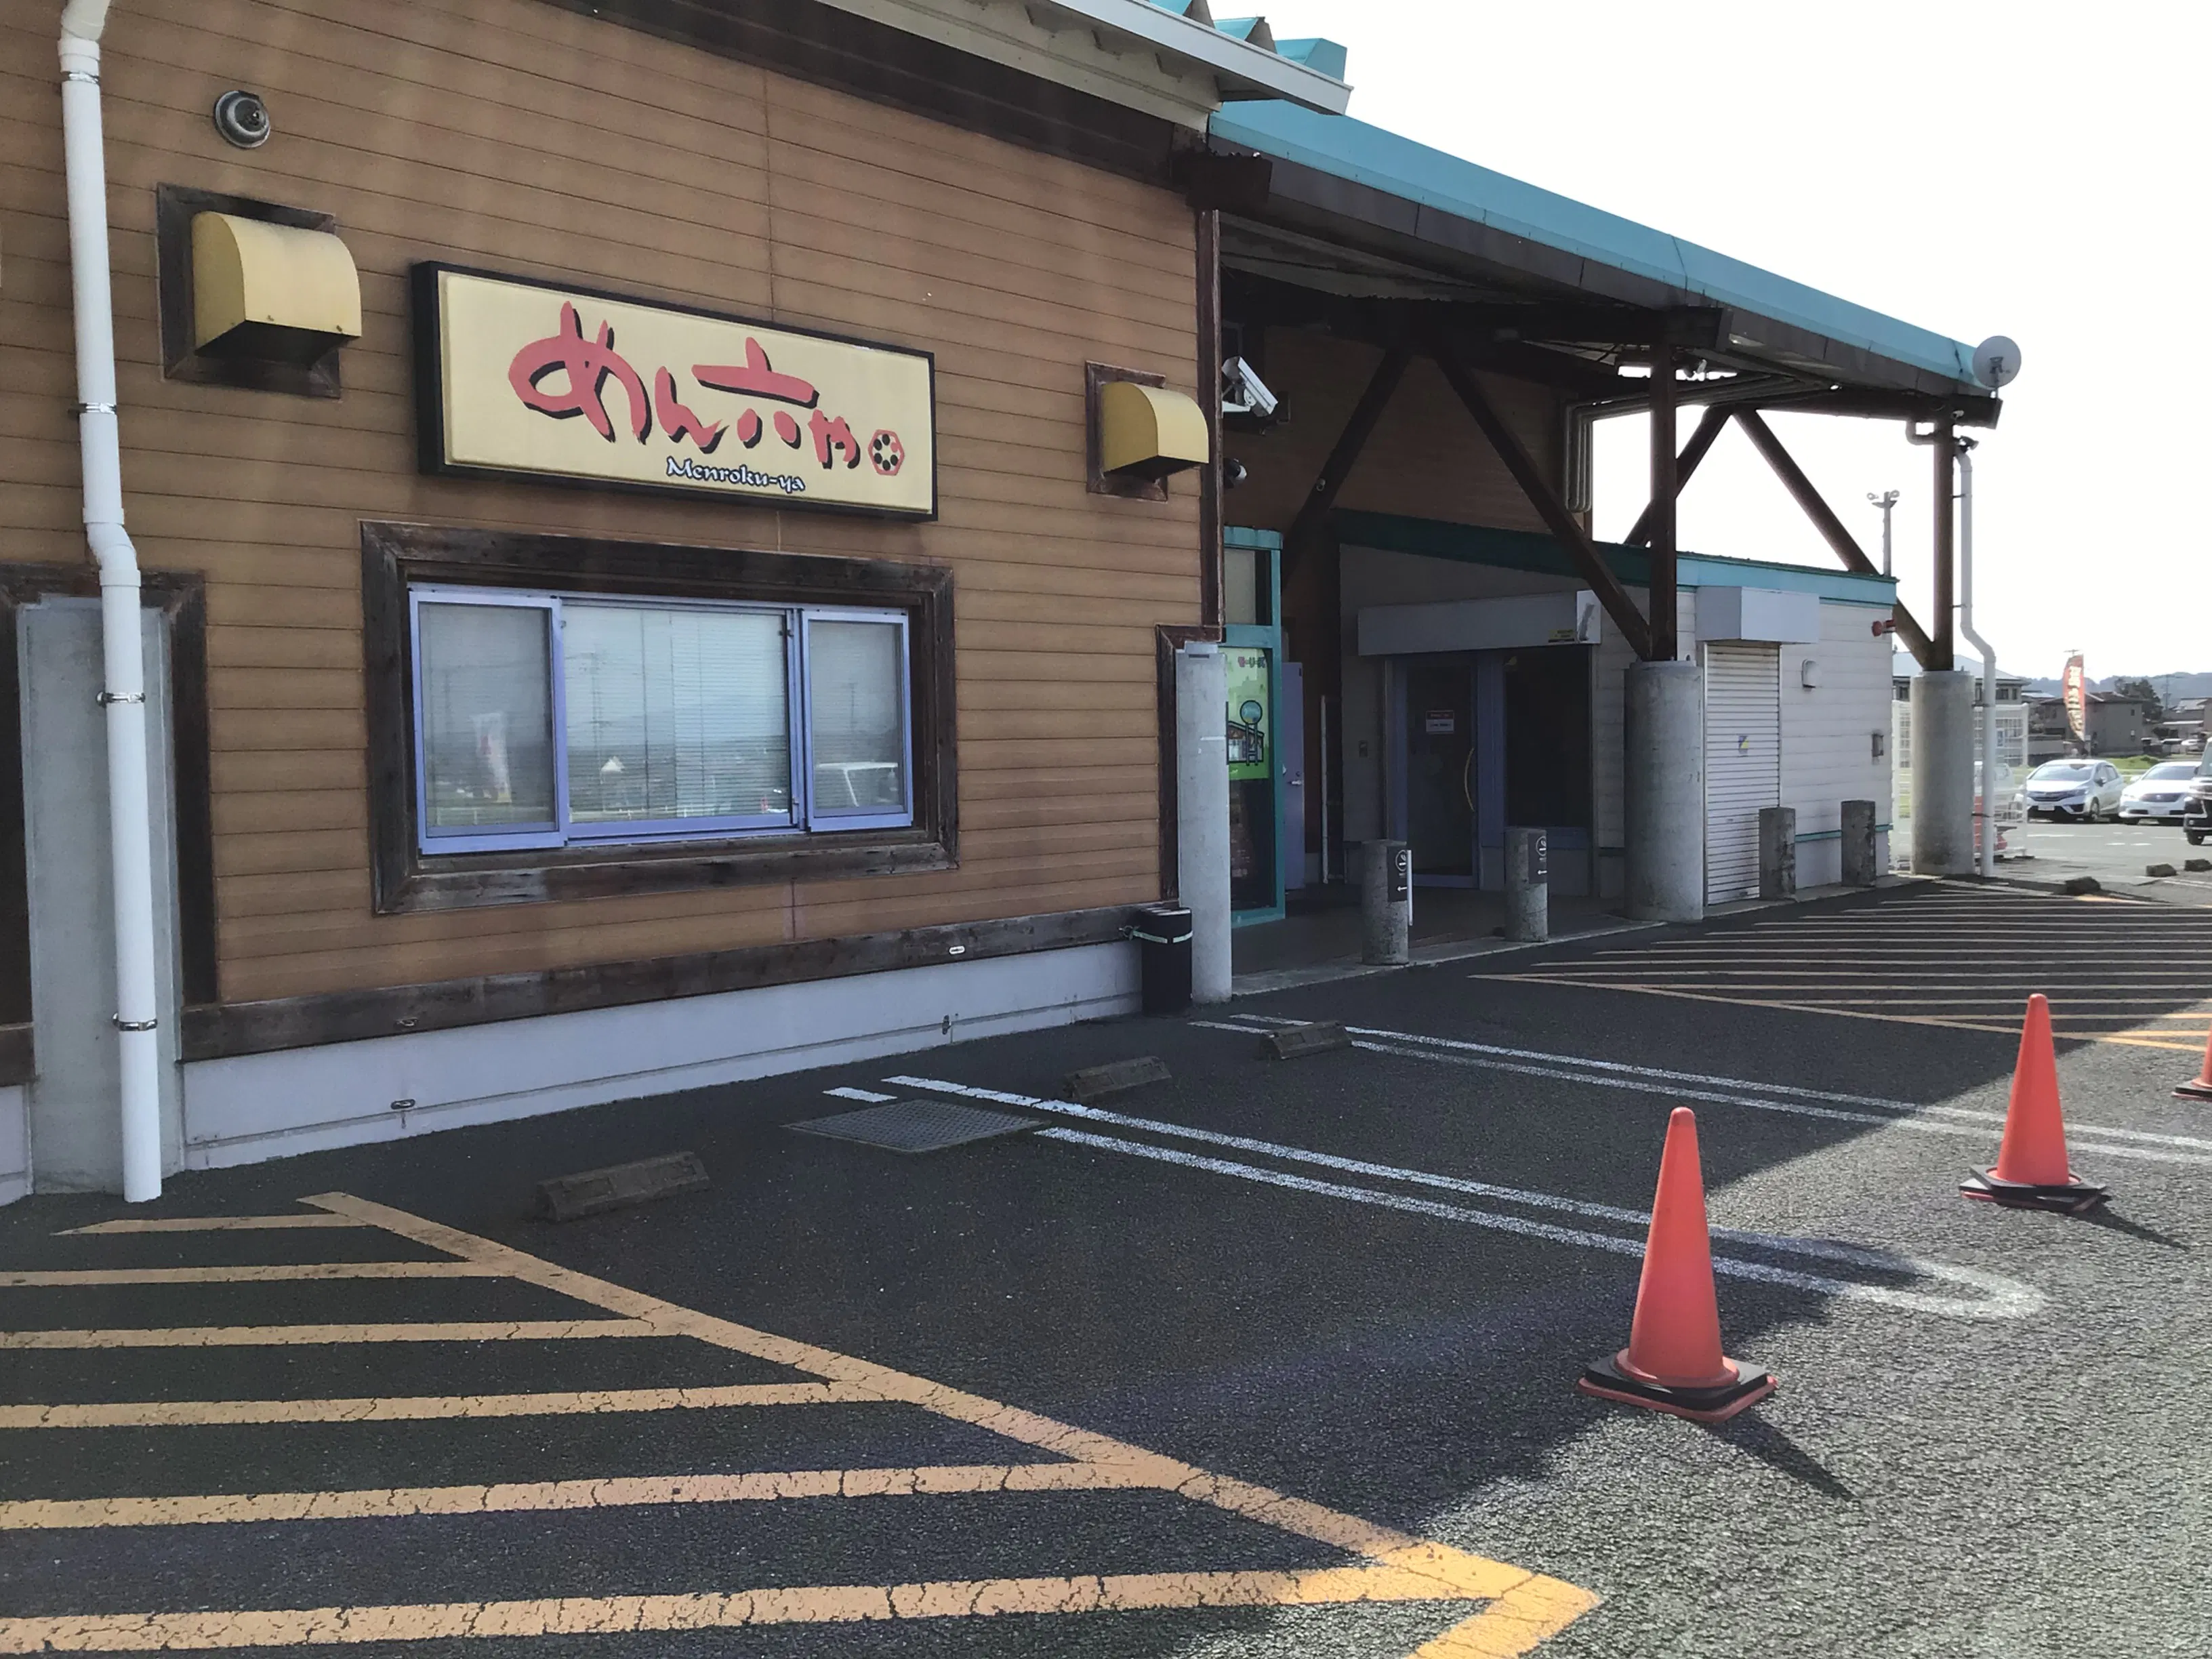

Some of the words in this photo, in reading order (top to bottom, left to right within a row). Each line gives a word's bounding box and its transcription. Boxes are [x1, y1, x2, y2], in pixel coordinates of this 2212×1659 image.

[508, 301, 860, 469] めん六や
[666, 456, 806, 493] Menroku-ya
